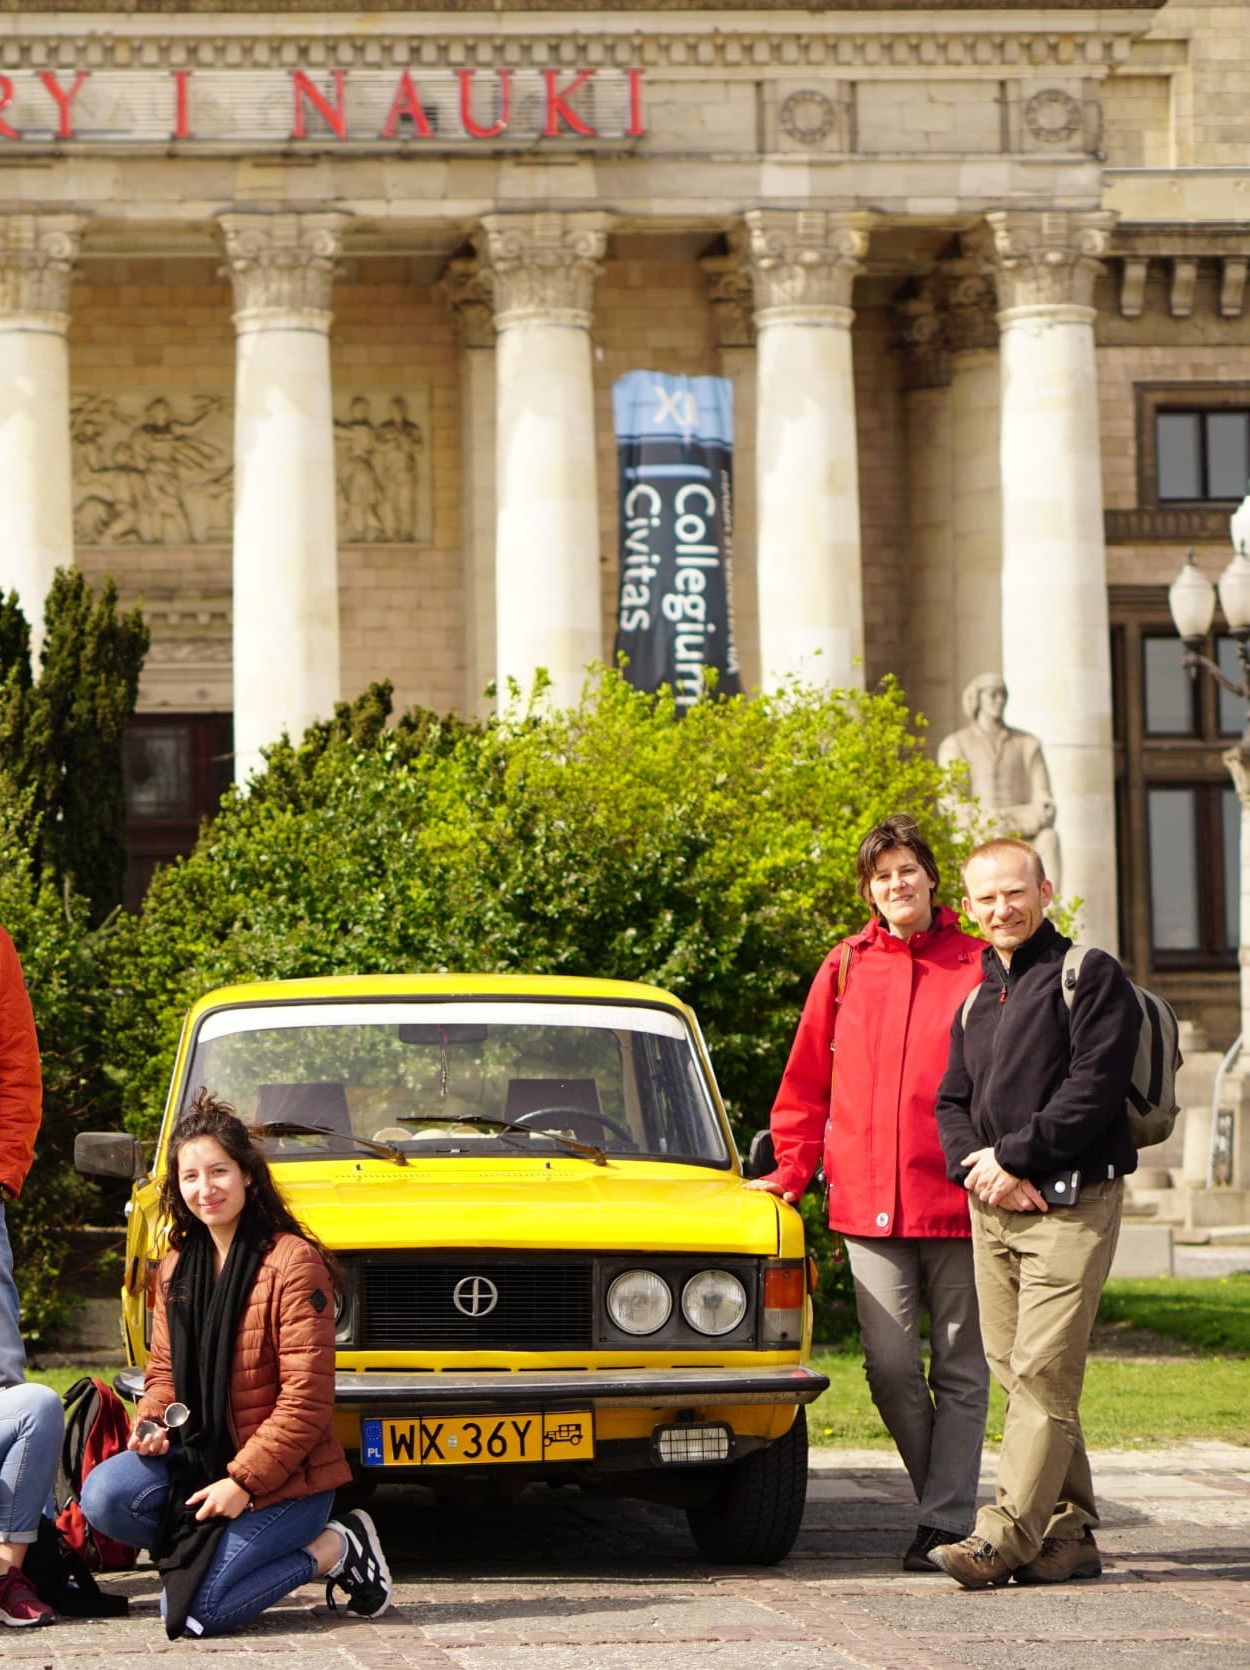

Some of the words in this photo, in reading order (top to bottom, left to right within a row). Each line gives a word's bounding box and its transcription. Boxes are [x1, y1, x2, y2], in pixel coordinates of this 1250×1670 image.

[170, 68, 194, 140] I
[290, 66, 647, 141] NAUKI
[620, 483, 662, 633] Civitas
[662, 483, 720, 706] Collegium
[367, 1447, 381, 1459] PL
[390, 1423, 445, 1461] WX
[462, 1420, 533, 1459] 36Y
